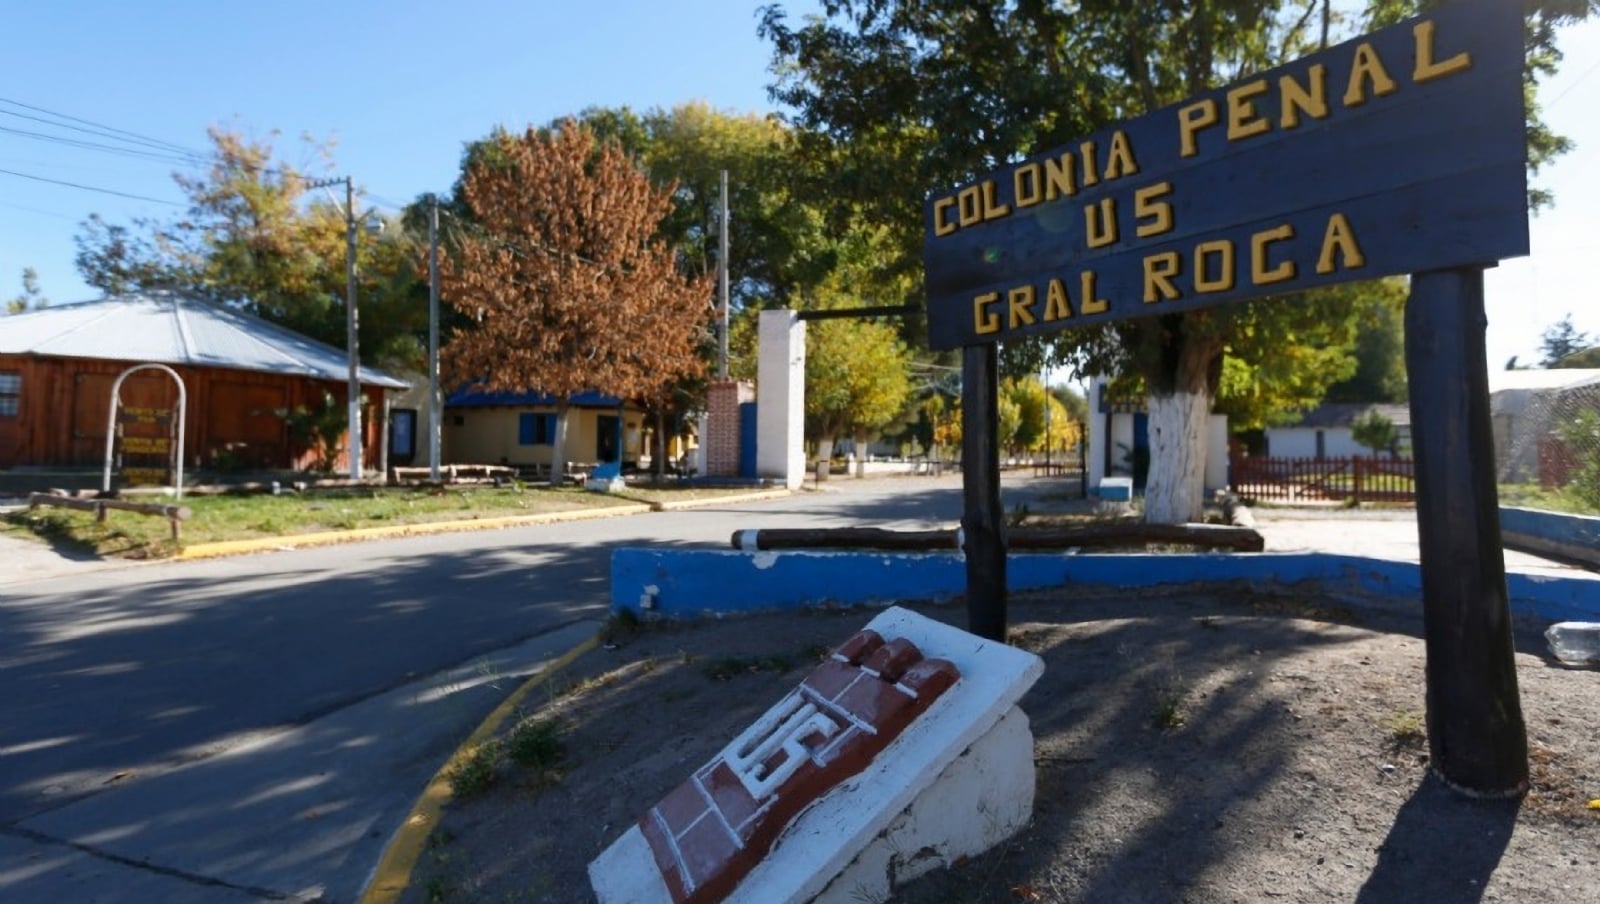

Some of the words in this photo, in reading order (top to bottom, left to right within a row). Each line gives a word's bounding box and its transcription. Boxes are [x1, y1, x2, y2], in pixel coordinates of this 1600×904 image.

[933, 130, 1137, 237] COLONIA
[1178, 20, 1470, 157] PENAL
[973, 272, 1108, 335] GRAL
[1143, 213, 1363, 303] ROCA
